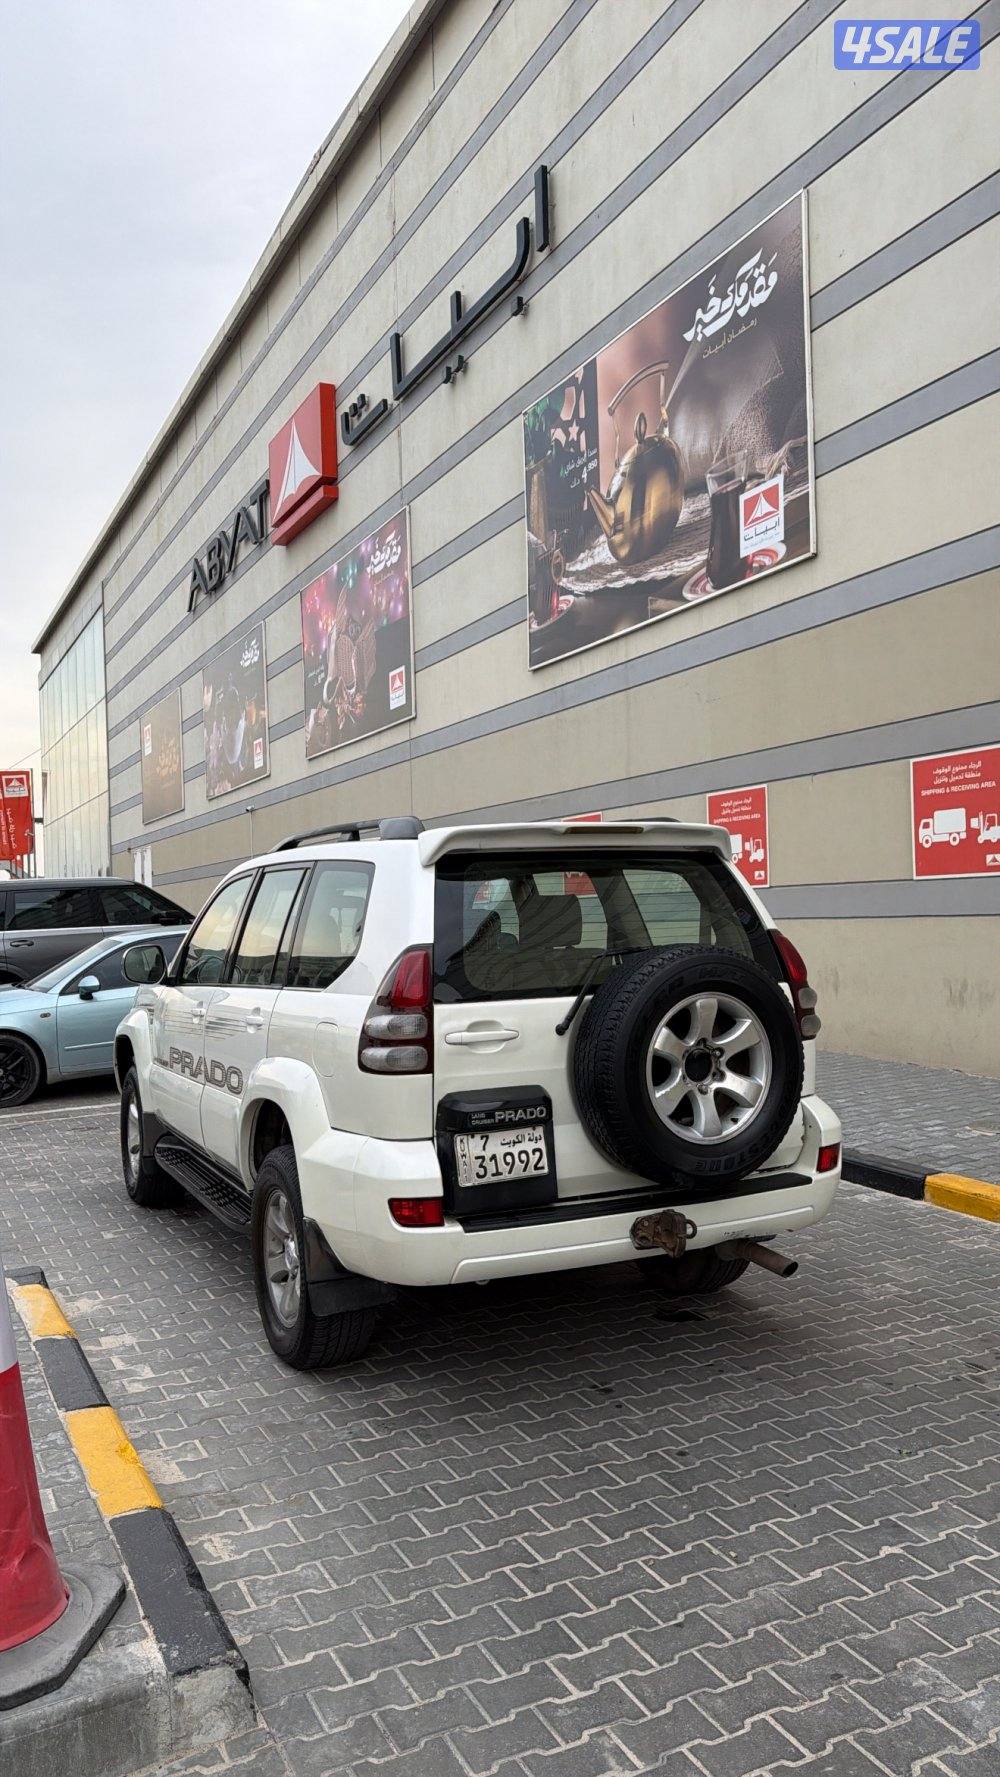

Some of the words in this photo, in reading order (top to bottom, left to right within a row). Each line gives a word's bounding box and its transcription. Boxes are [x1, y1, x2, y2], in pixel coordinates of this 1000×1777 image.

[727, 318, 758, 343] رمضان
[187, 479, 271, 613] ABYAT
[932, 765, 952, 775] الوقوف
[949, 772, 964, 783] تحميل
[952, 764, 968, 774] ممنوع
[921, 787, 945, 797] SHIPPING
[950, 783, 980, 792] RECEIVING
[980, 780, 996, 789] AREA
[169, 1046, 243, 1095] PRADO
[494, 1106, 547, 1123] PRADO
[480, 1134, 490, 1151] 7
[500, 1134, 526, 1148] الكويت
[527, 1131, 542, 1143] دولة
[474, 1147, 545, 1180] 31992
